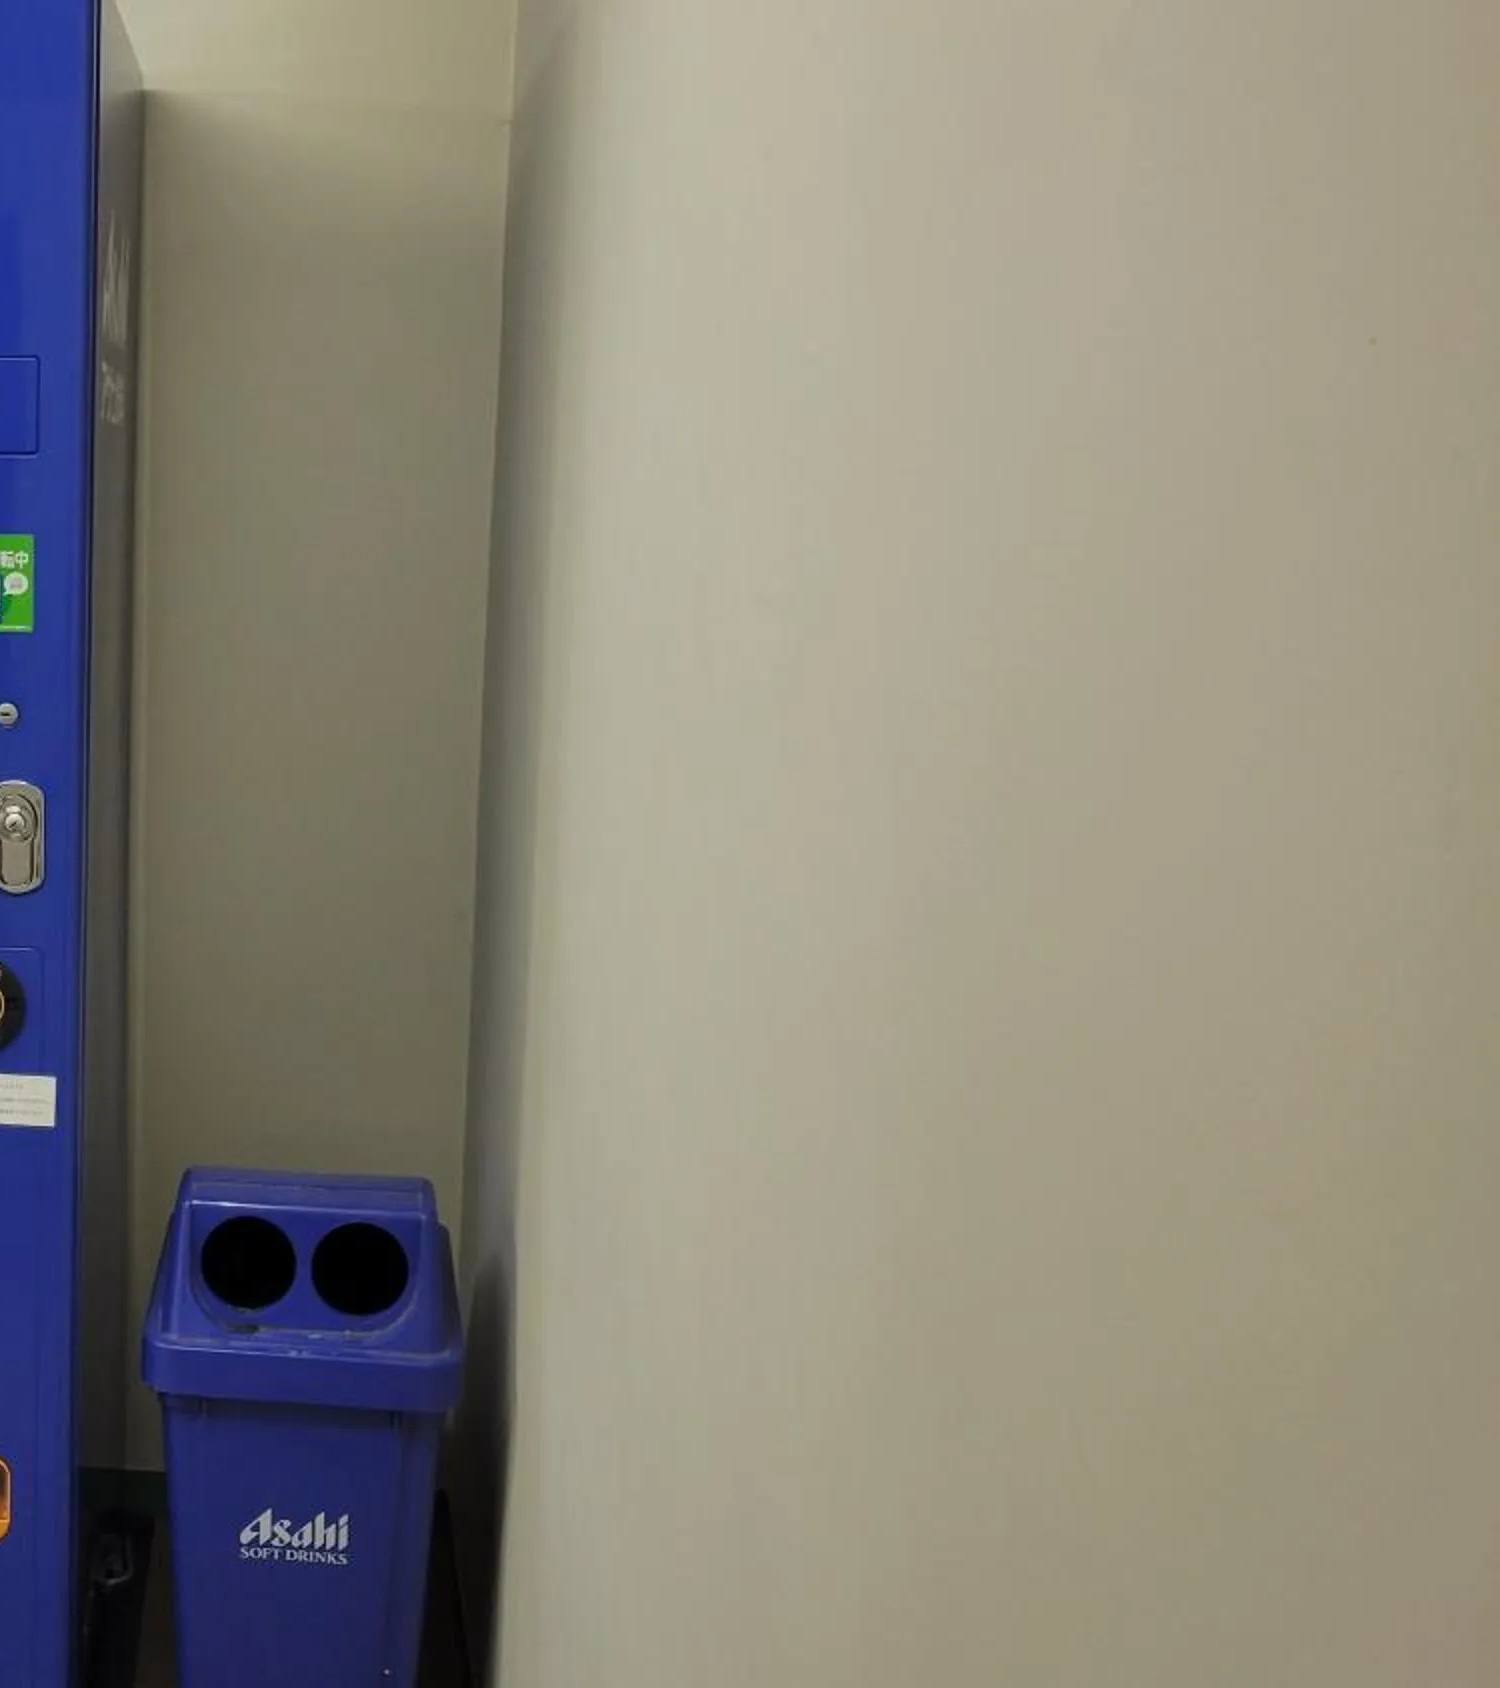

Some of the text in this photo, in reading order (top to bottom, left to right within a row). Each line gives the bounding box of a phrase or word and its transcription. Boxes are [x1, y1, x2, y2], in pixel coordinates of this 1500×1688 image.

[239, 1508, 349, 1550] Asahi
[240, 1546, 349, 1566] SOFT DRINKS
